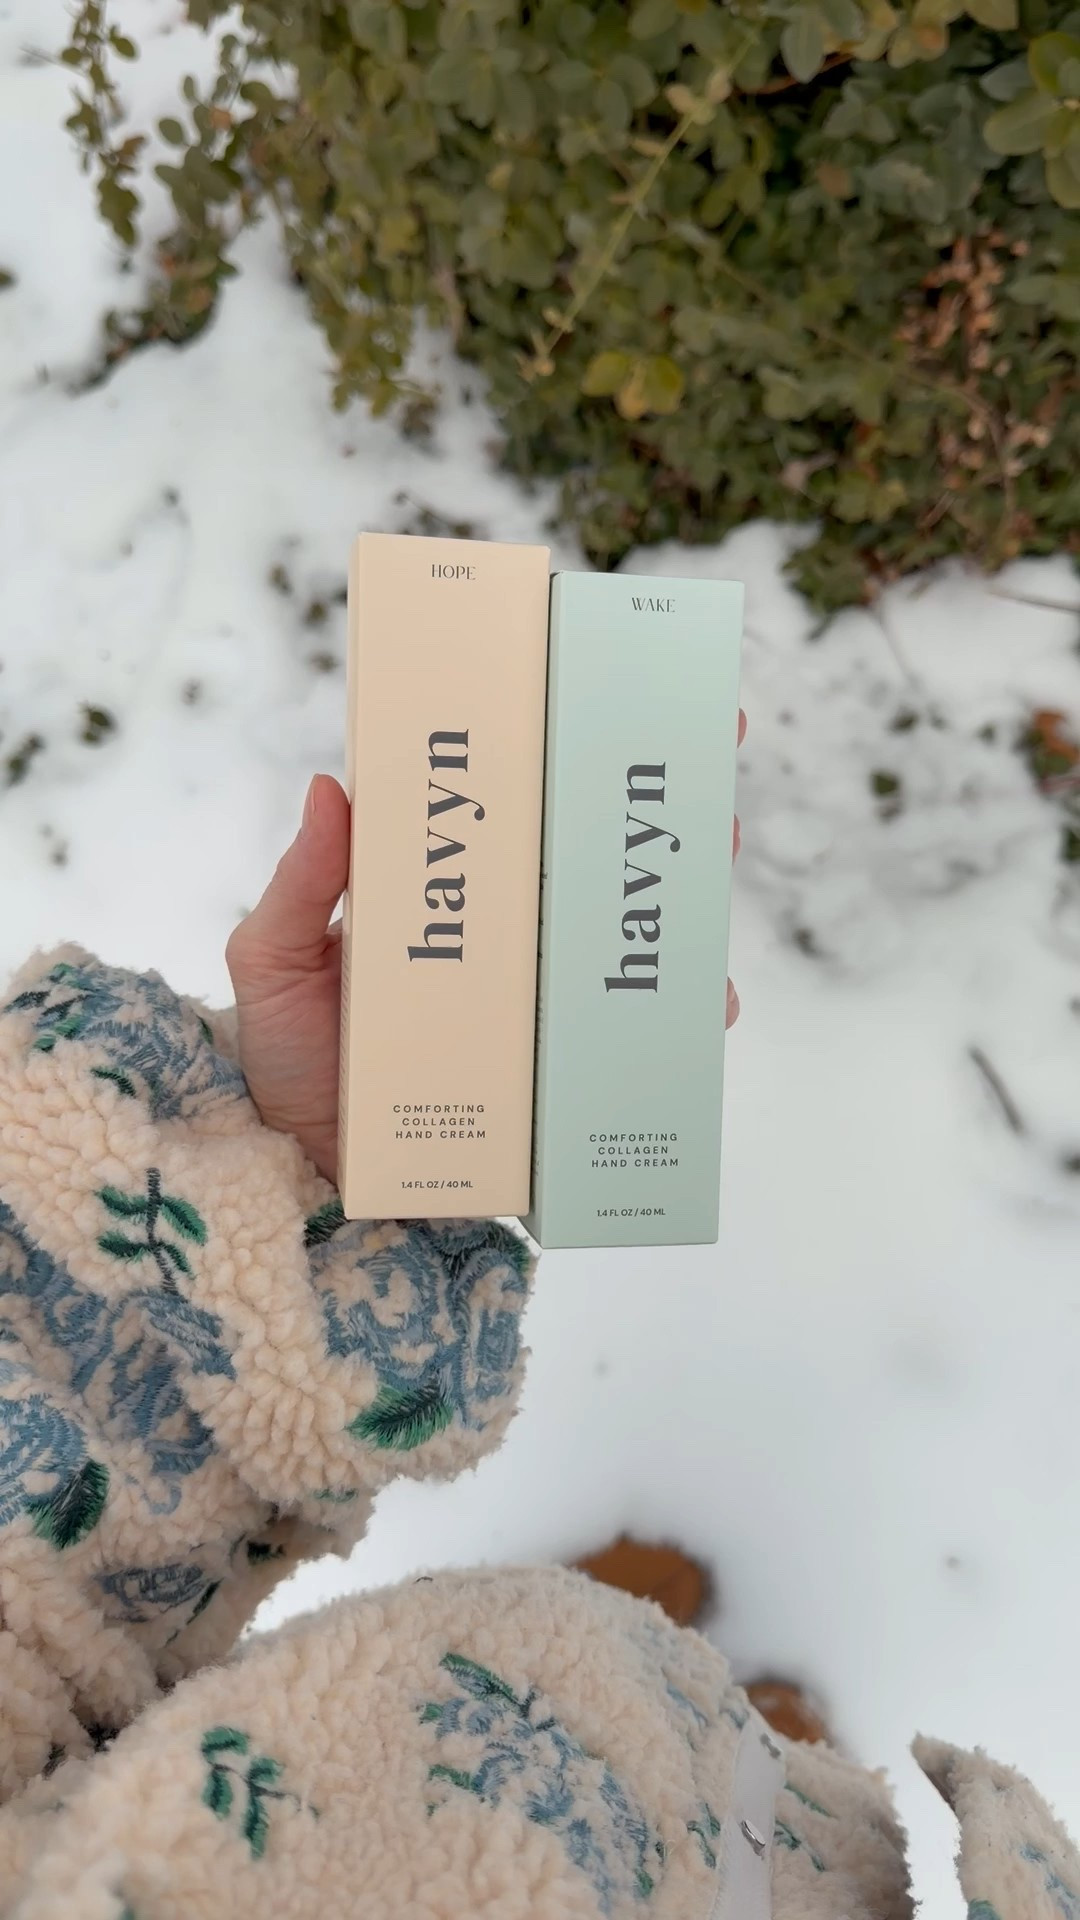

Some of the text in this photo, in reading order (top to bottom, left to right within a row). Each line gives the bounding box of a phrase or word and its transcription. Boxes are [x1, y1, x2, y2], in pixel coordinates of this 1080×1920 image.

[432, 564, 475, 580] HOPE
[632, 597, 675, 612] WAKE
[407, 729, 485, 963] havyn
[604, 762, 680, 993] havyn
[393, 1104, 484, 1114] COMFORTING
[402, 1117, 474, 1127] COLLAGEN
[396, 1130, 485, 1140] HAND CREAM
[590, 1132, 677, 1143] COMFORTING
[598, 1145, 668, 1156] COLLAGEN
[592, 1158, 678, 1168] HAND CREAM
[402, 1181, 412, 1189] 1.4
[415, 1180, 424, 1189] FL
[427, 1180, 438, 1189] OZ
[447, 1180, 458, 1189] 40
[461, 1180, 473, 1189] ML
[597, 1209, 607, 1218] 1.4
[610, 1208, 619, 1217] FL
[621, 1208, 632, 1217] OZ
[640, 1207, 652, 1217] 40
[654, 1207, 665, 1216] ML
